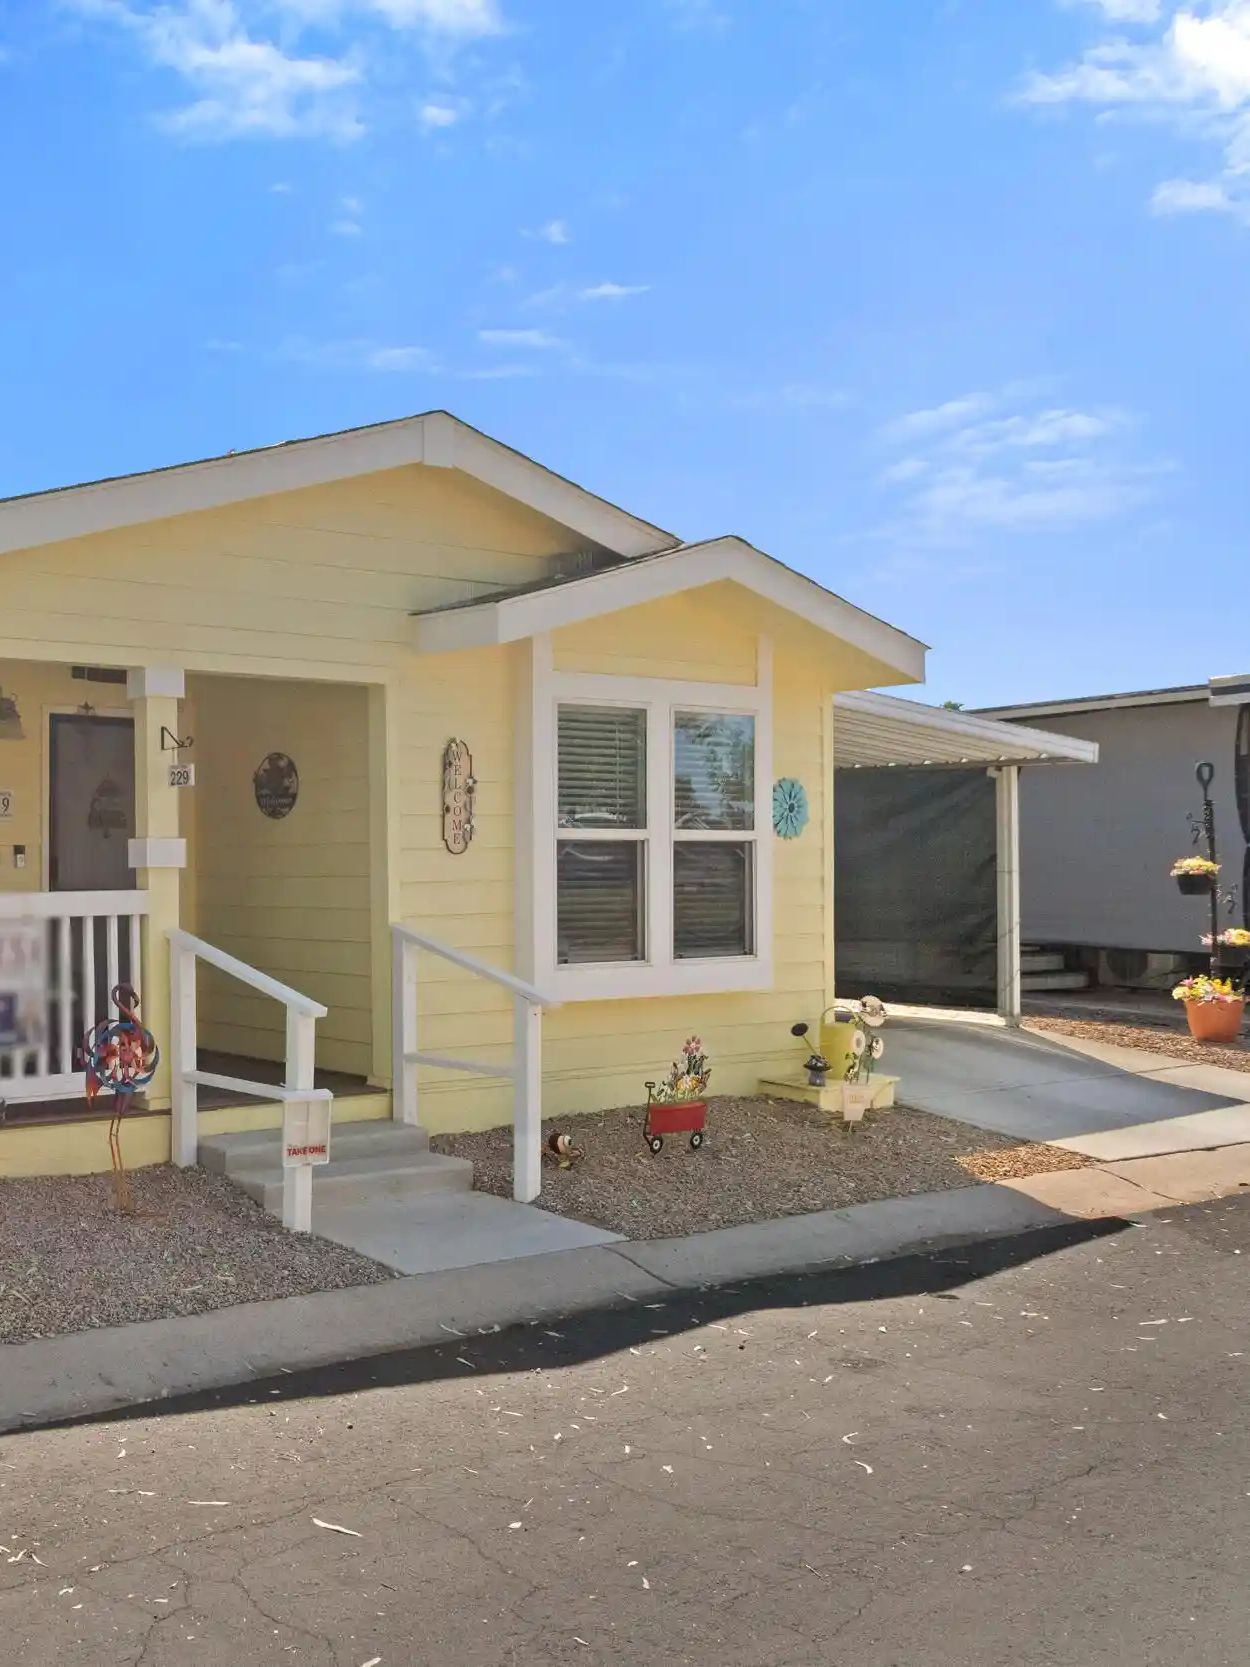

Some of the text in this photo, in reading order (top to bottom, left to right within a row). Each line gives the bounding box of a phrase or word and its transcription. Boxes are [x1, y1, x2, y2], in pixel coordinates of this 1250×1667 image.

[170, 770, 189, 786] 229
[452, 751, 463, 845] WELCOME
[286, 1144, 326, 1157] TAKE ONE
